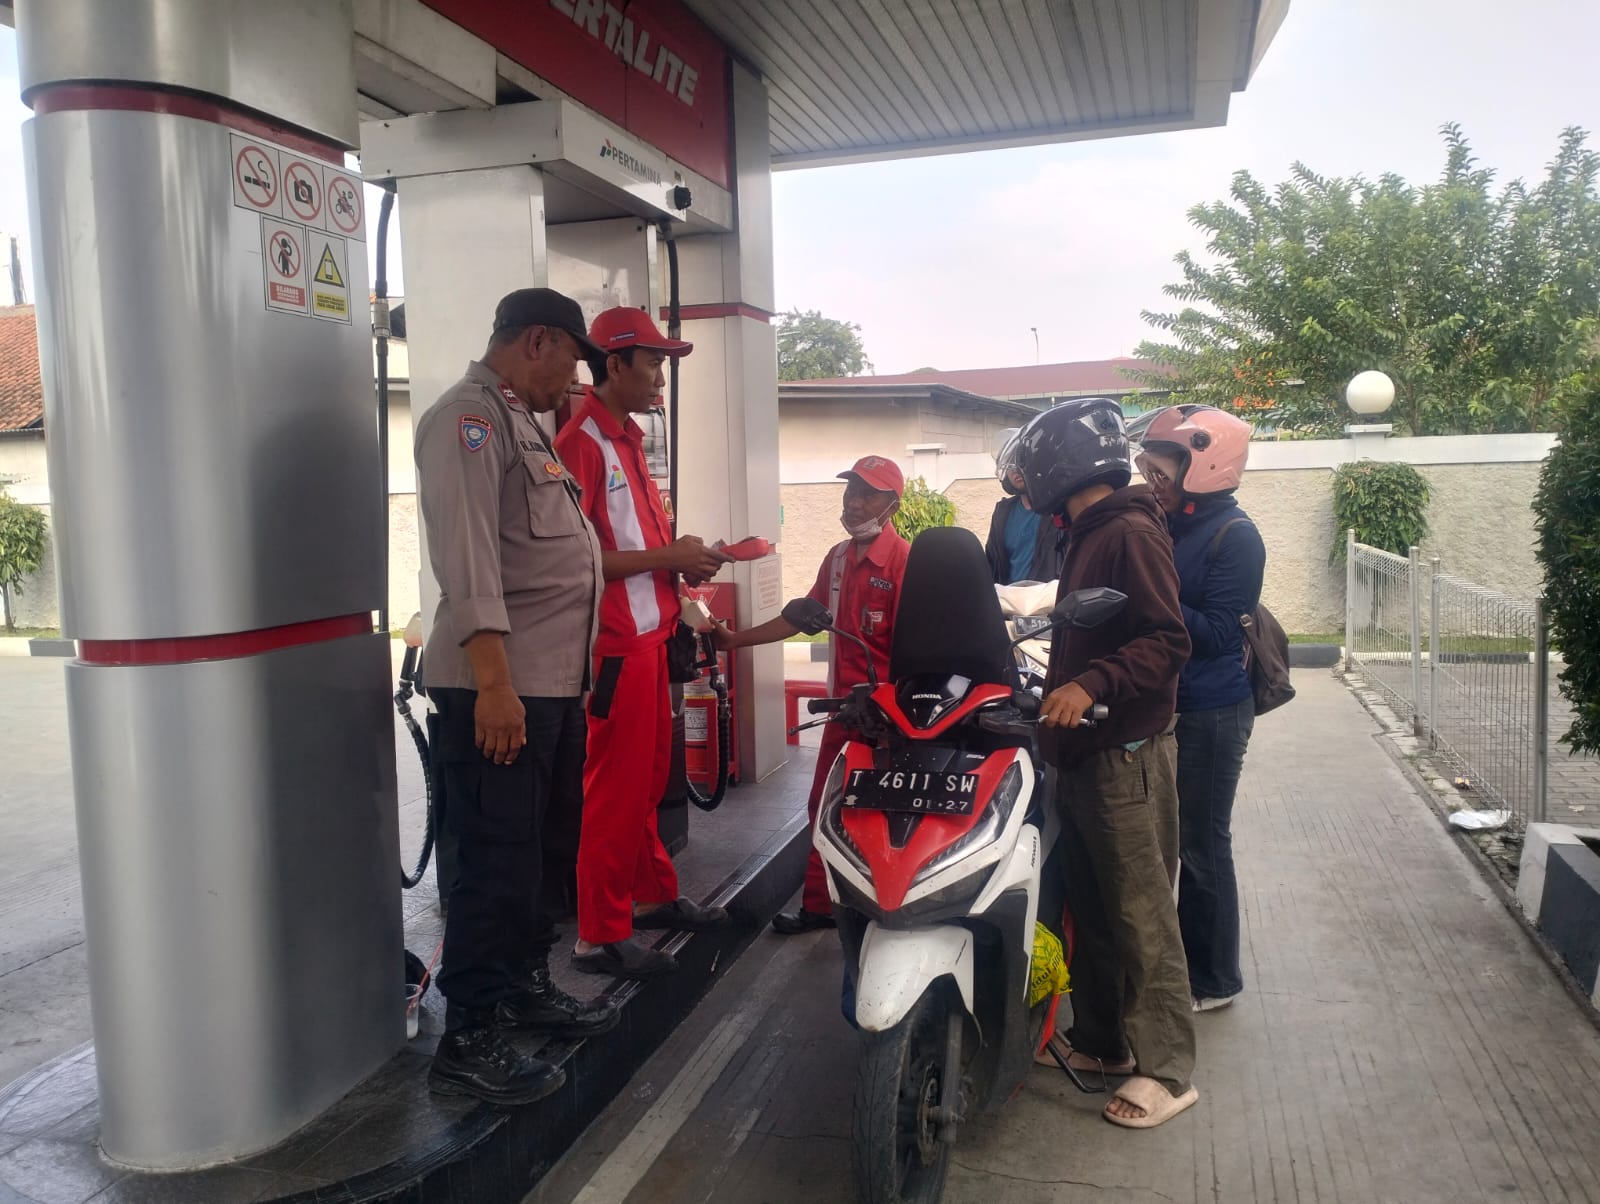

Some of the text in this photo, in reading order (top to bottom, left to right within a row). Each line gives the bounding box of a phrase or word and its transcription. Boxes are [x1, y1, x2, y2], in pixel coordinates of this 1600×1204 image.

[612, 147, 662, 187] PERTAMINA
[851, 770, 976, 793] T 4611 SW
